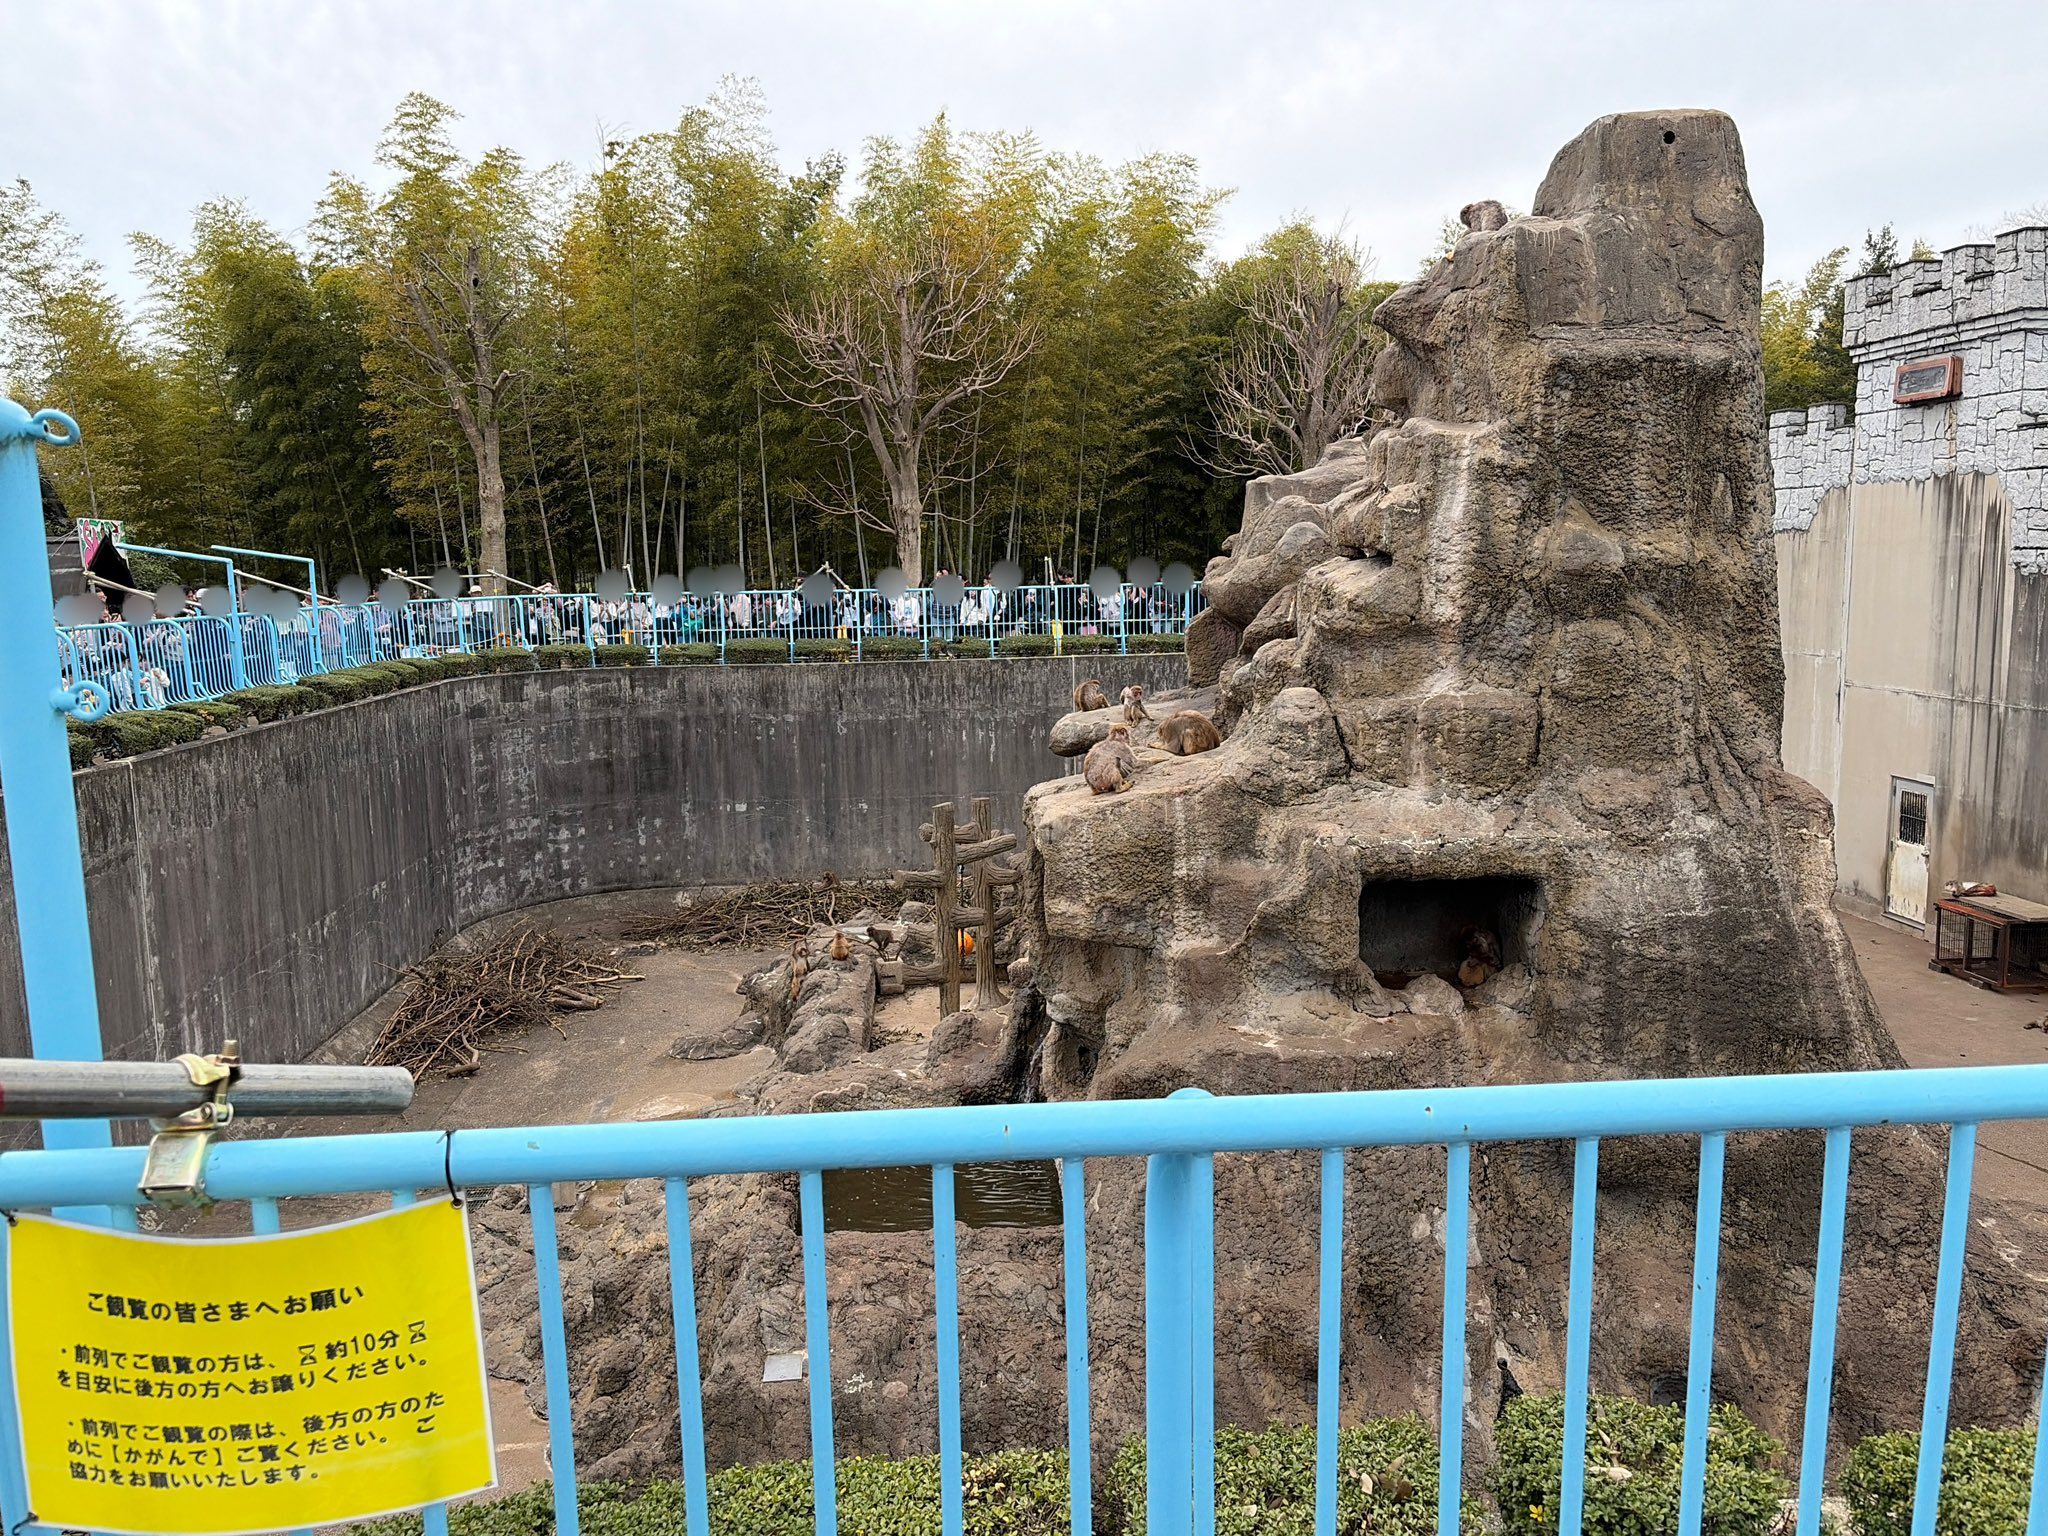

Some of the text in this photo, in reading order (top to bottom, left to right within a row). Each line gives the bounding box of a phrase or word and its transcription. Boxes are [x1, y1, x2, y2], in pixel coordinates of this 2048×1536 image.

[88, 1286, 365, 1325] ご観覧の皆さまへお願い
[69, 1461, 320, 1490] 協力をお願いいたします。
